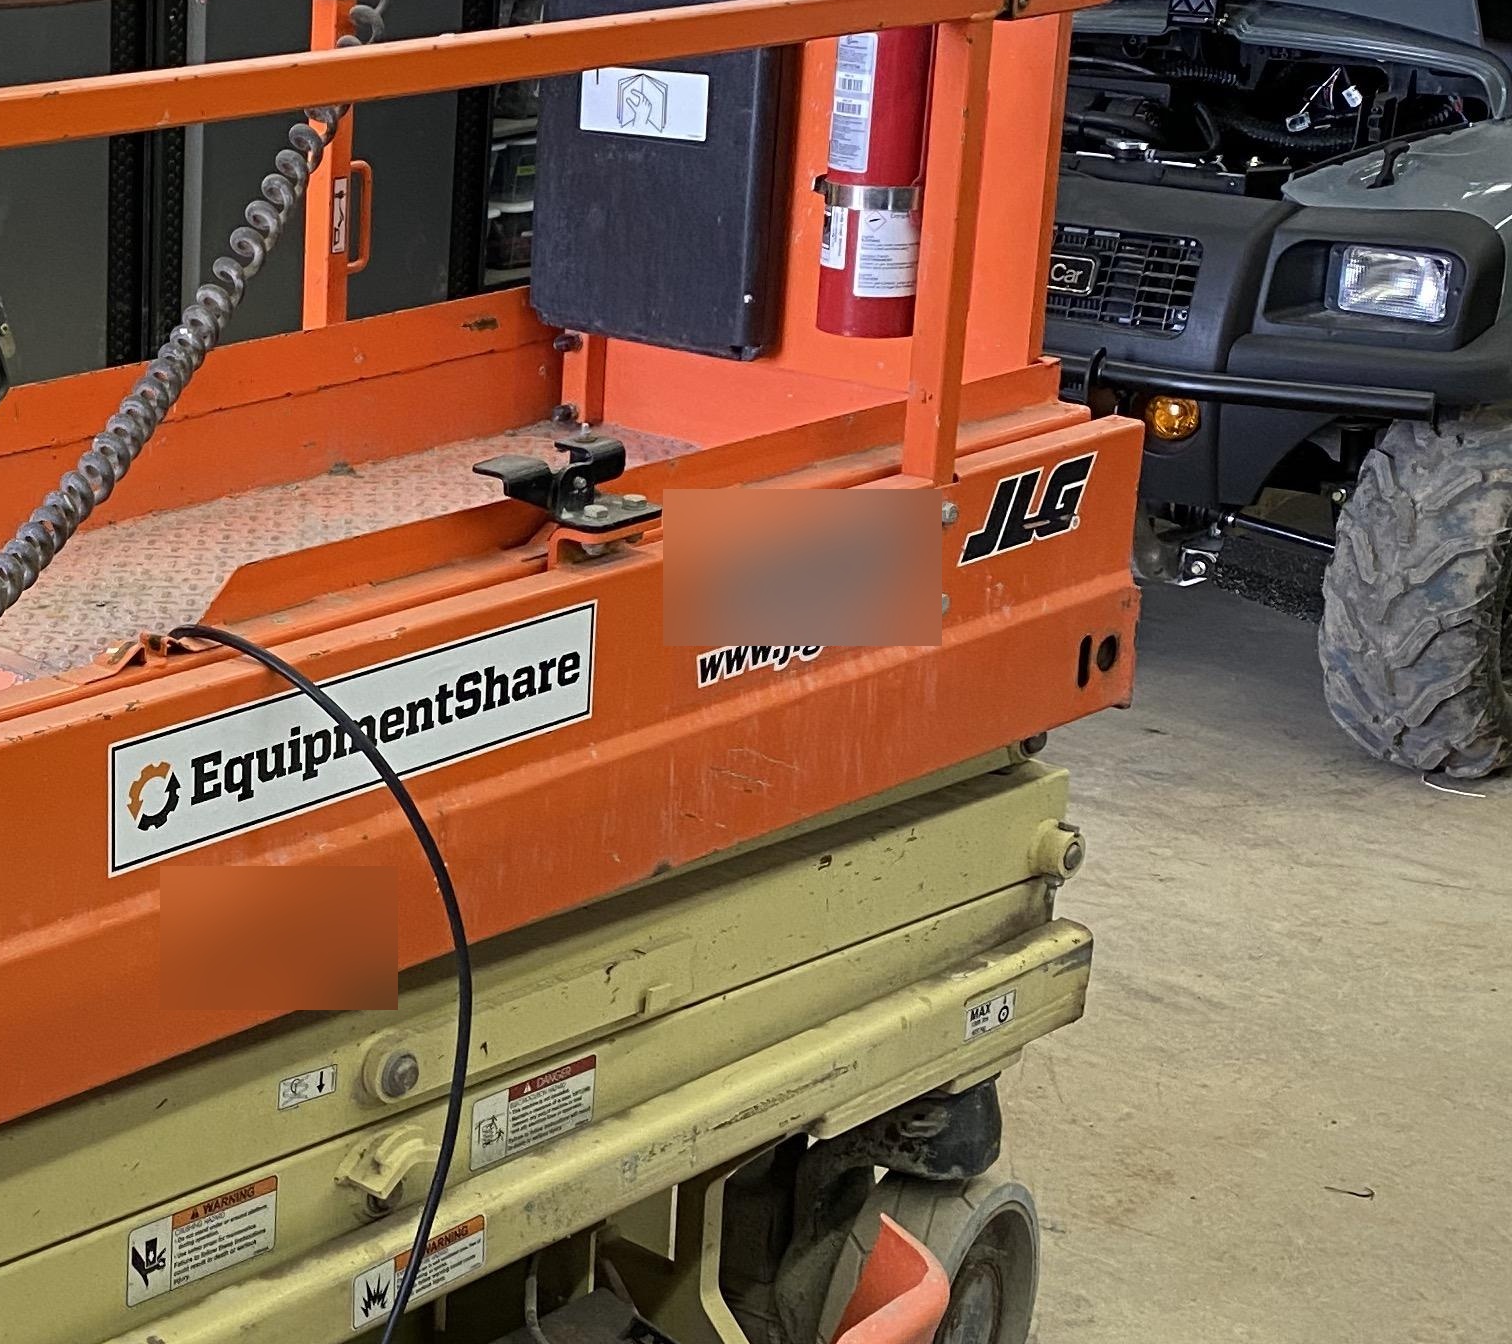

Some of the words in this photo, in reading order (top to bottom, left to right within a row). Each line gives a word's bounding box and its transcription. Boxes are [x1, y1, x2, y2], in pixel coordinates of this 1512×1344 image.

[1050, 263, 1084, 284] Car
[957, 451, 1098, 568] JLG
[190, 651, 581, 806] EquipmentShare
[970, 1001, 992, 1023] MAX
[536, 1066, 572, 1088] DANGER
[202, 1184, 256, 1215] WARNING
